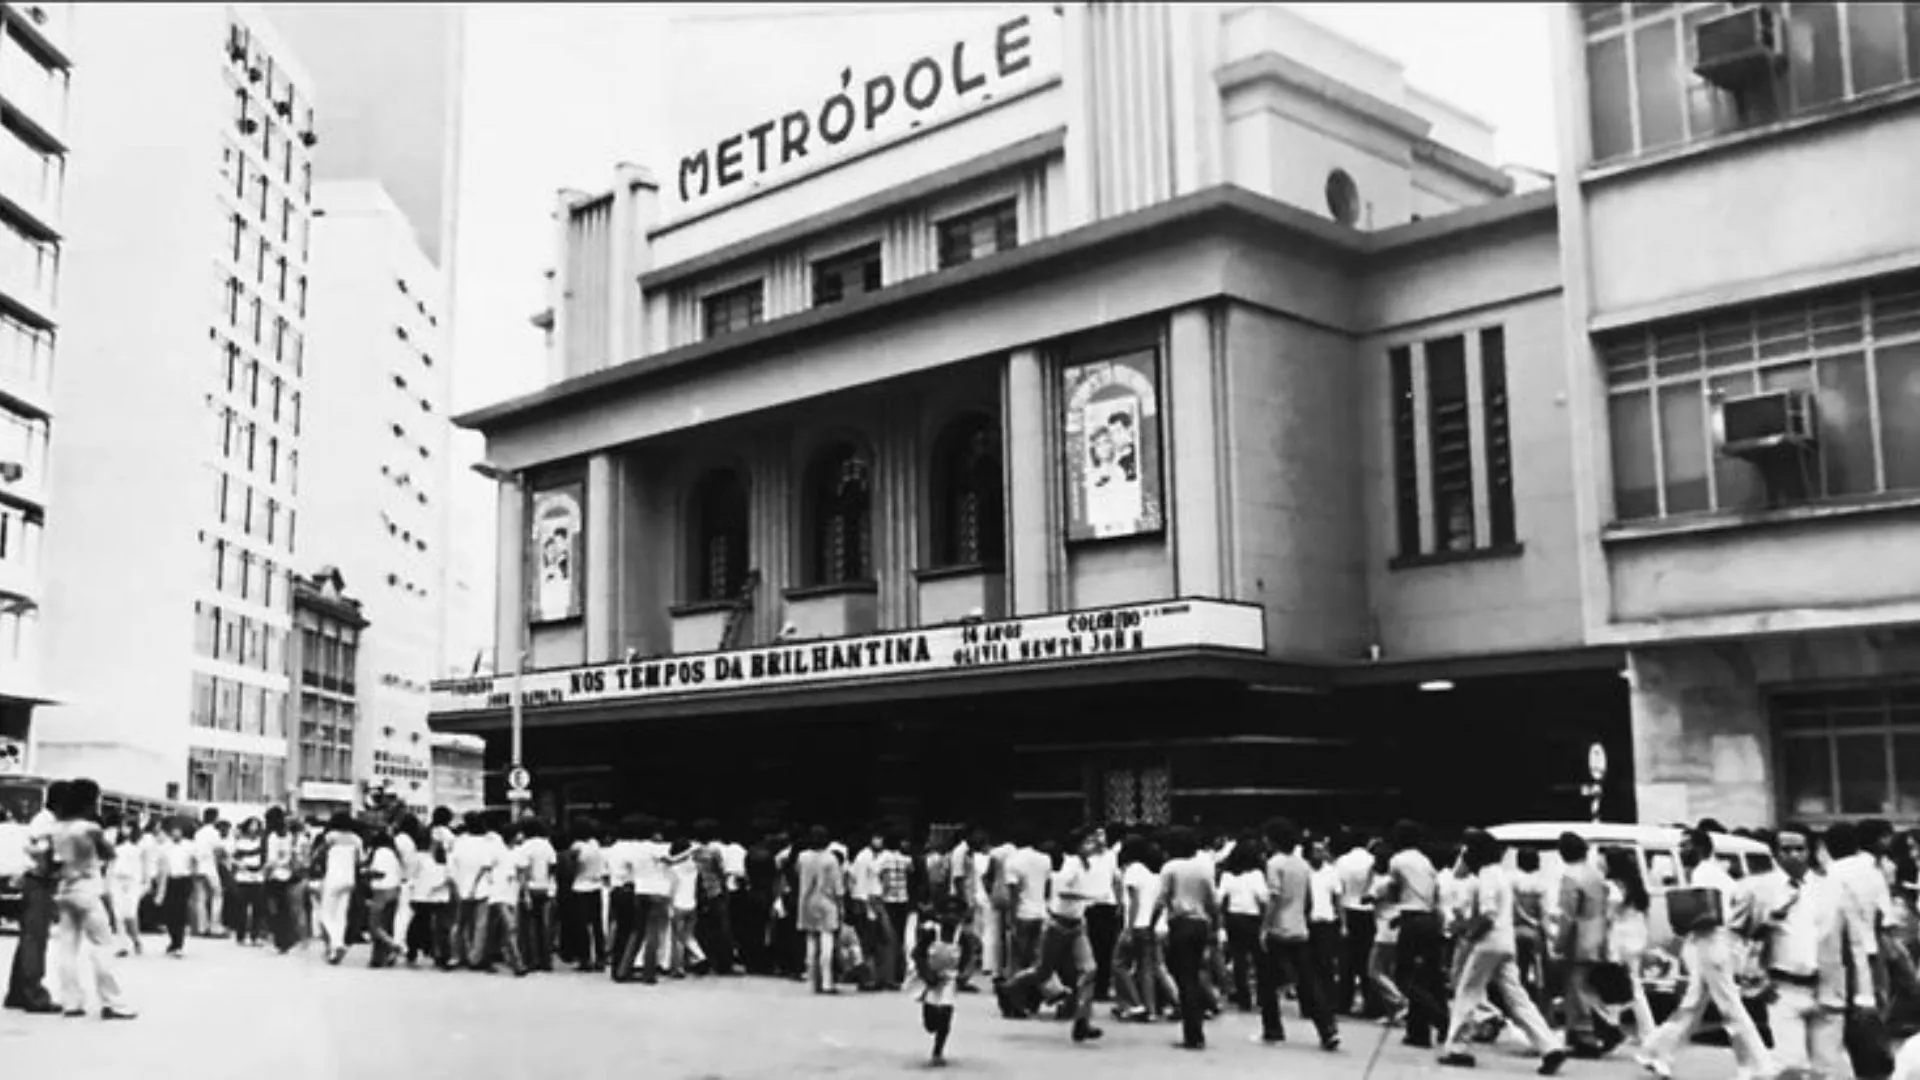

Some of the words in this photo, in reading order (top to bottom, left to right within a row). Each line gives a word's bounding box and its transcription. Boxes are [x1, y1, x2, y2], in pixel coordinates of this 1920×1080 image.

[678, 14, 1031, 202] METRÓPOLE
[570, 670, 605, 694] NOS
[616, 660, 706, 690] TEMPOS
[714, 655, 744, 680] DA
[751, 635, 931, 678] BRILHANTINA
[953, 643, 1007, 664] OLIVIA
